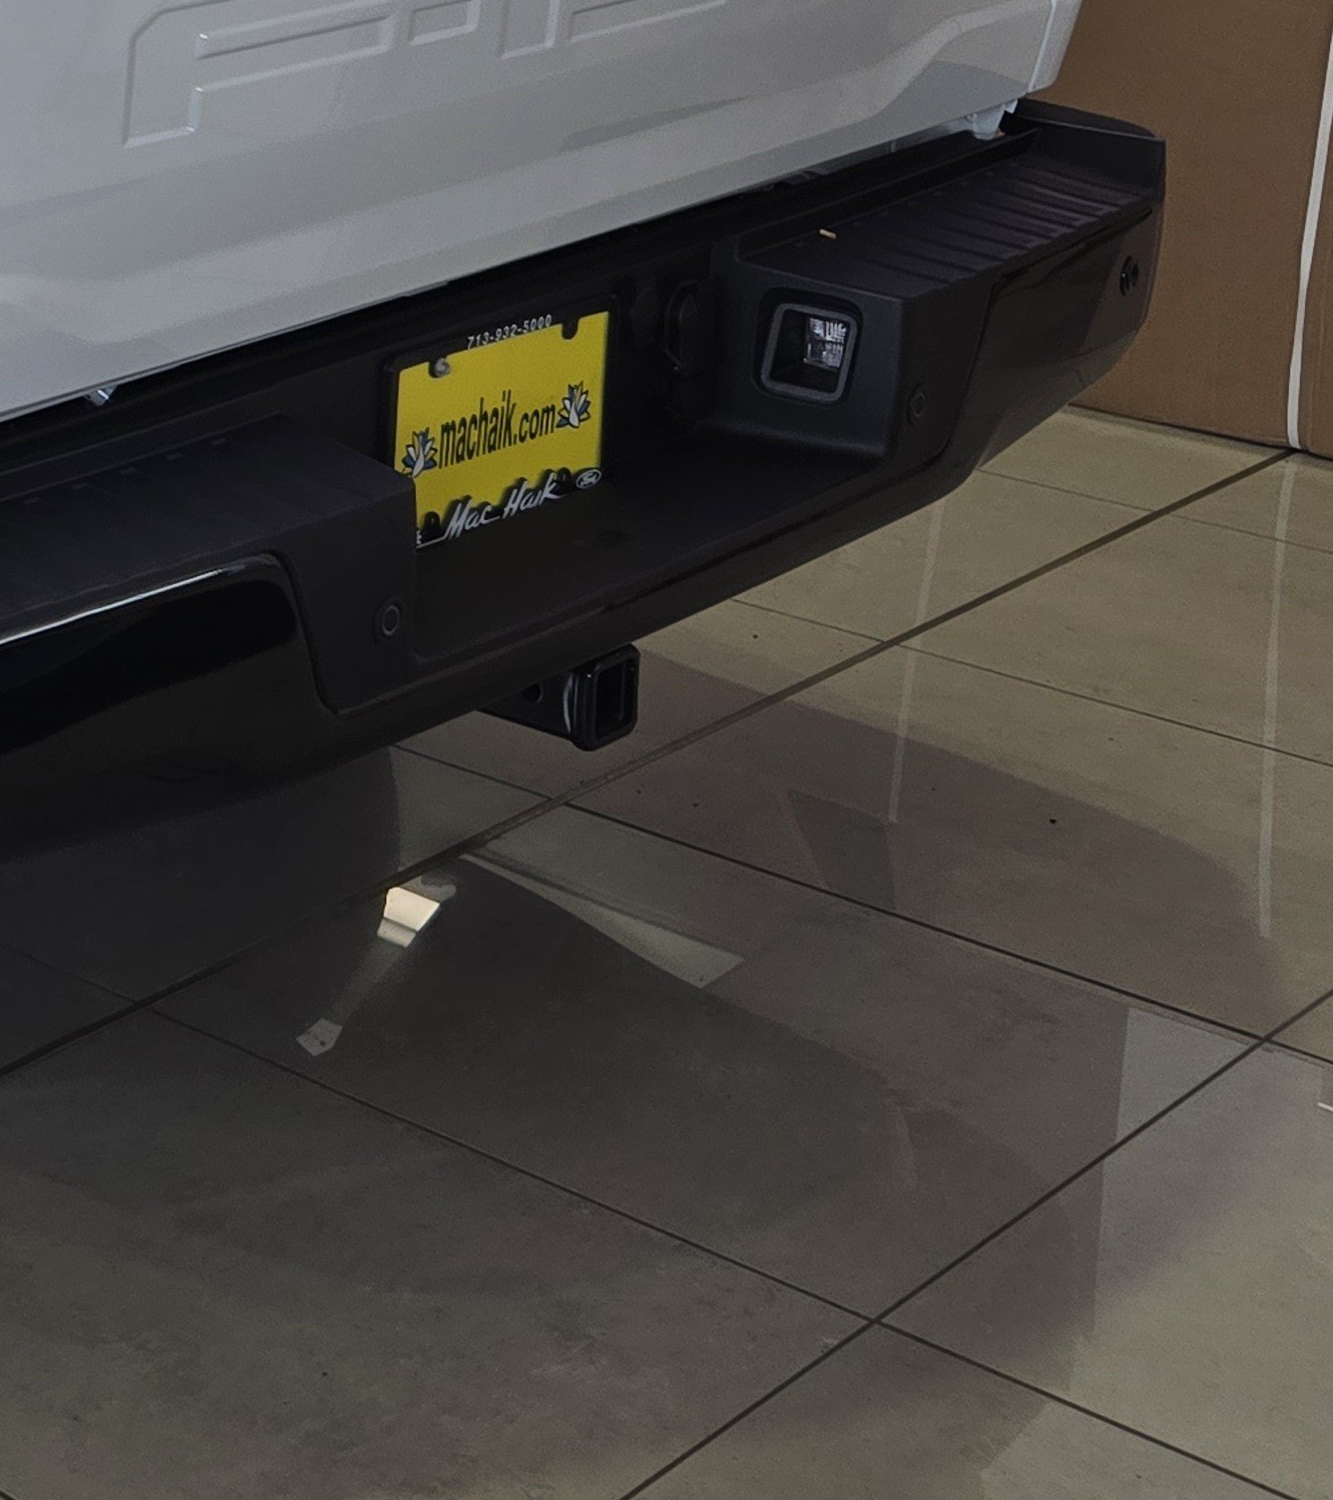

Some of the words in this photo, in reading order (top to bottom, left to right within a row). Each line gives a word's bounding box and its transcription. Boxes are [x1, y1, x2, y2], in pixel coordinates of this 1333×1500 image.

[466, 313, 553, 350] 713-932-5000
[438, 389, 556, 470] machaik.com
[501, 473, 564, 519] Haik
